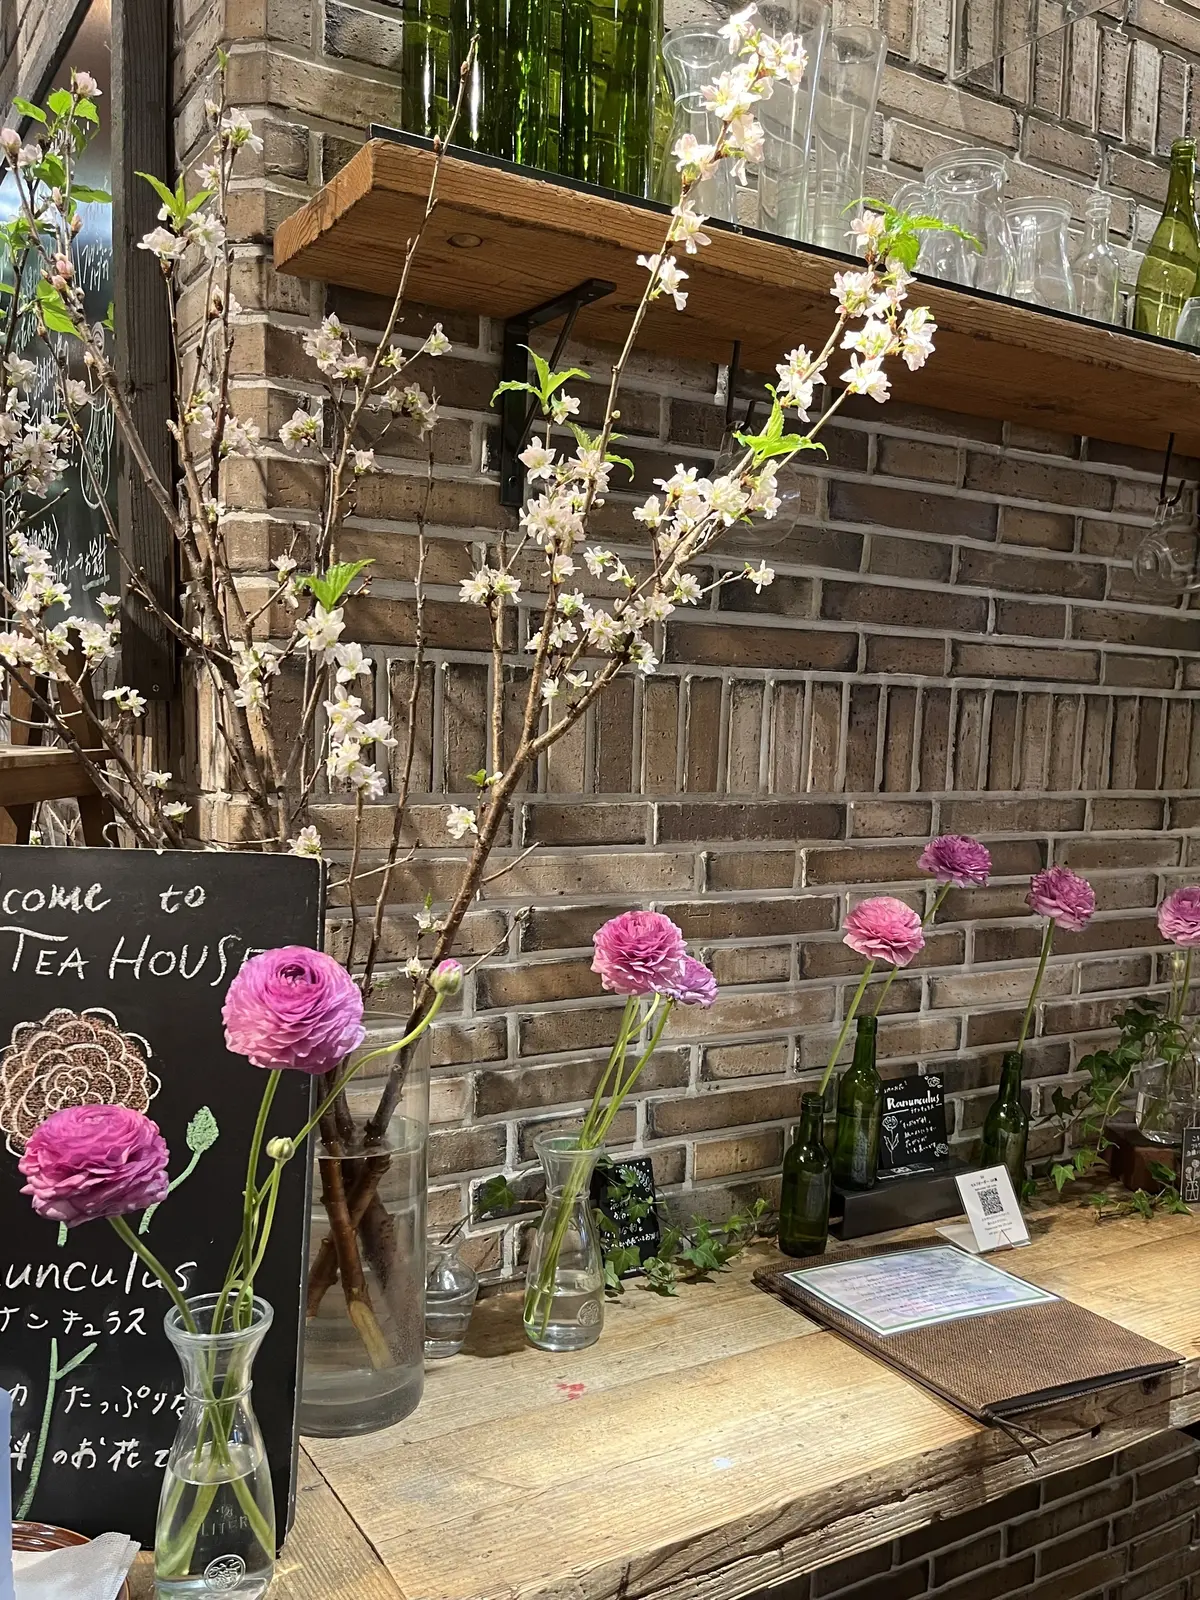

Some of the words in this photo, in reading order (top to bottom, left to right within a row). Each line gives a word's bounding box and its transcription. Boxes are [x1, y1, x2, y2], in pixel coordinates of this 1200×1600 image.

[159, 885, 206, 913] to
[0, 926, 89, 980] TEA
[886, 1090, 940, 1110] Ranunculus
